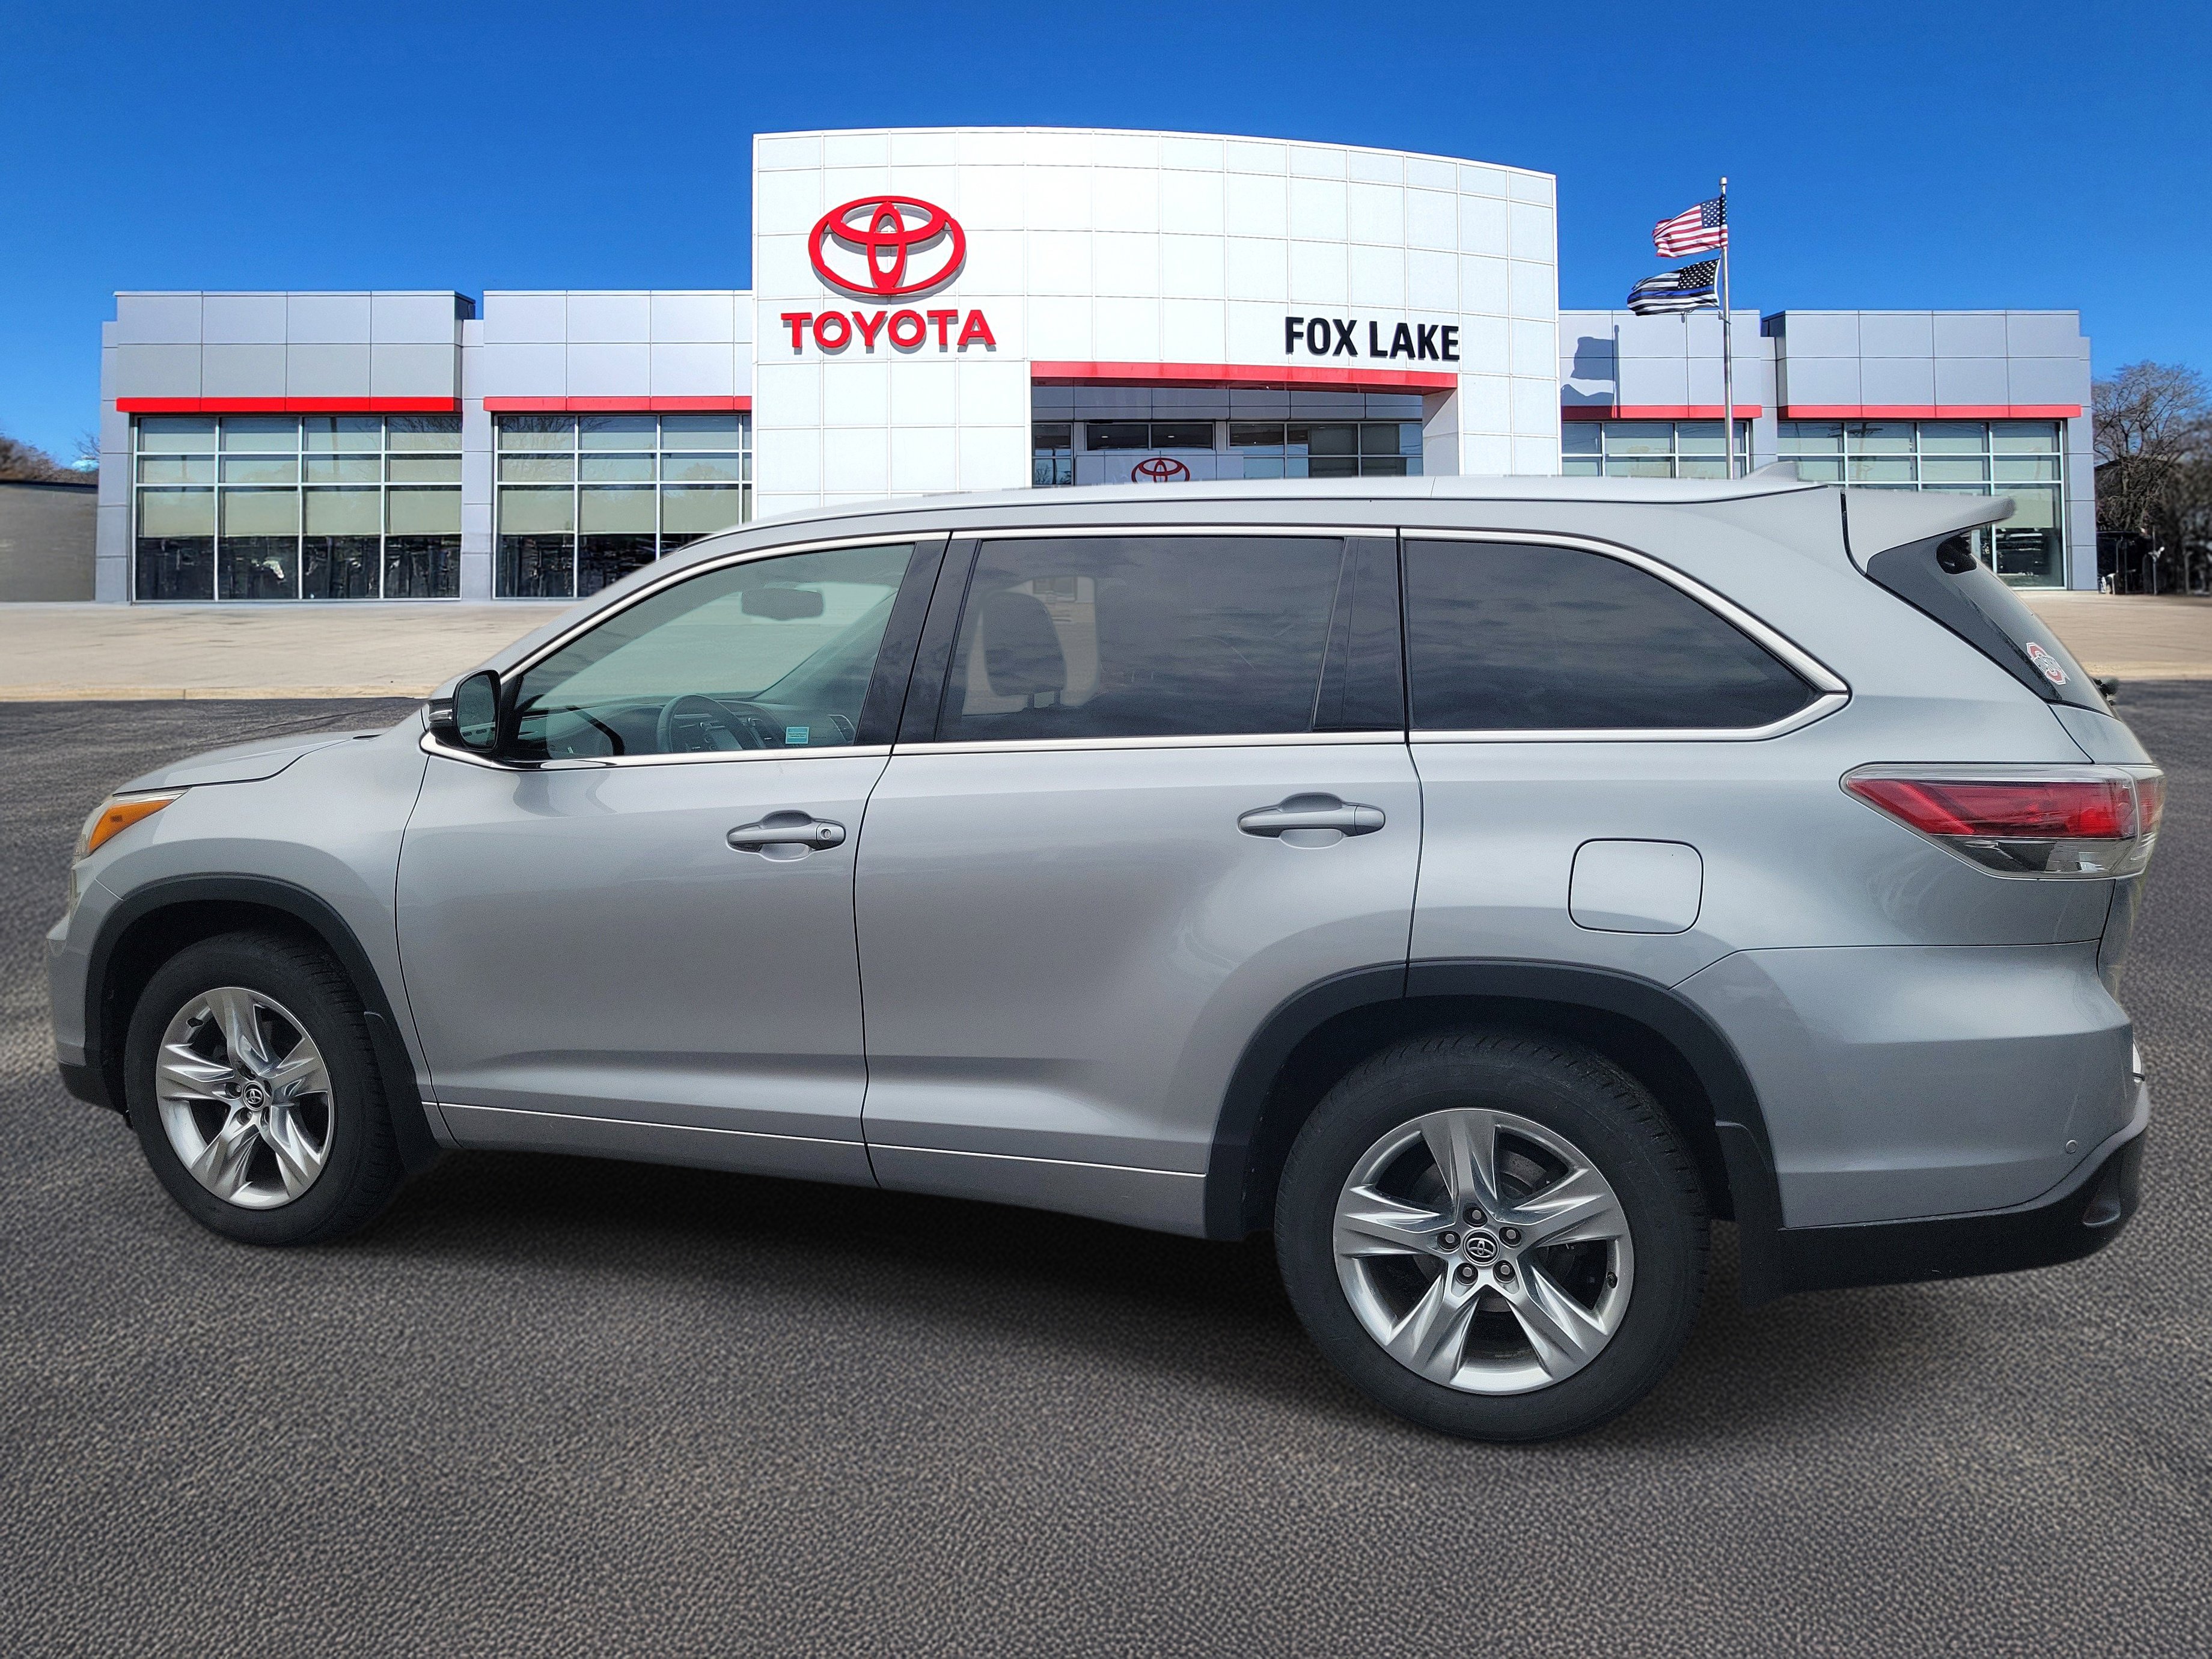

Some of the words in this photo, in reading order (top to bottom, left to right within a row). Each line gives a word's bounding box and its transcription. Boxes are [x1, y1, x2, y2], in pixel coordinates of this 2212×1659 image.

[781, 310, 997, 350] TOYOTA
[1285, 316, 1358, 356] FOX
[1369, 320, 1460, 361] LAKE
